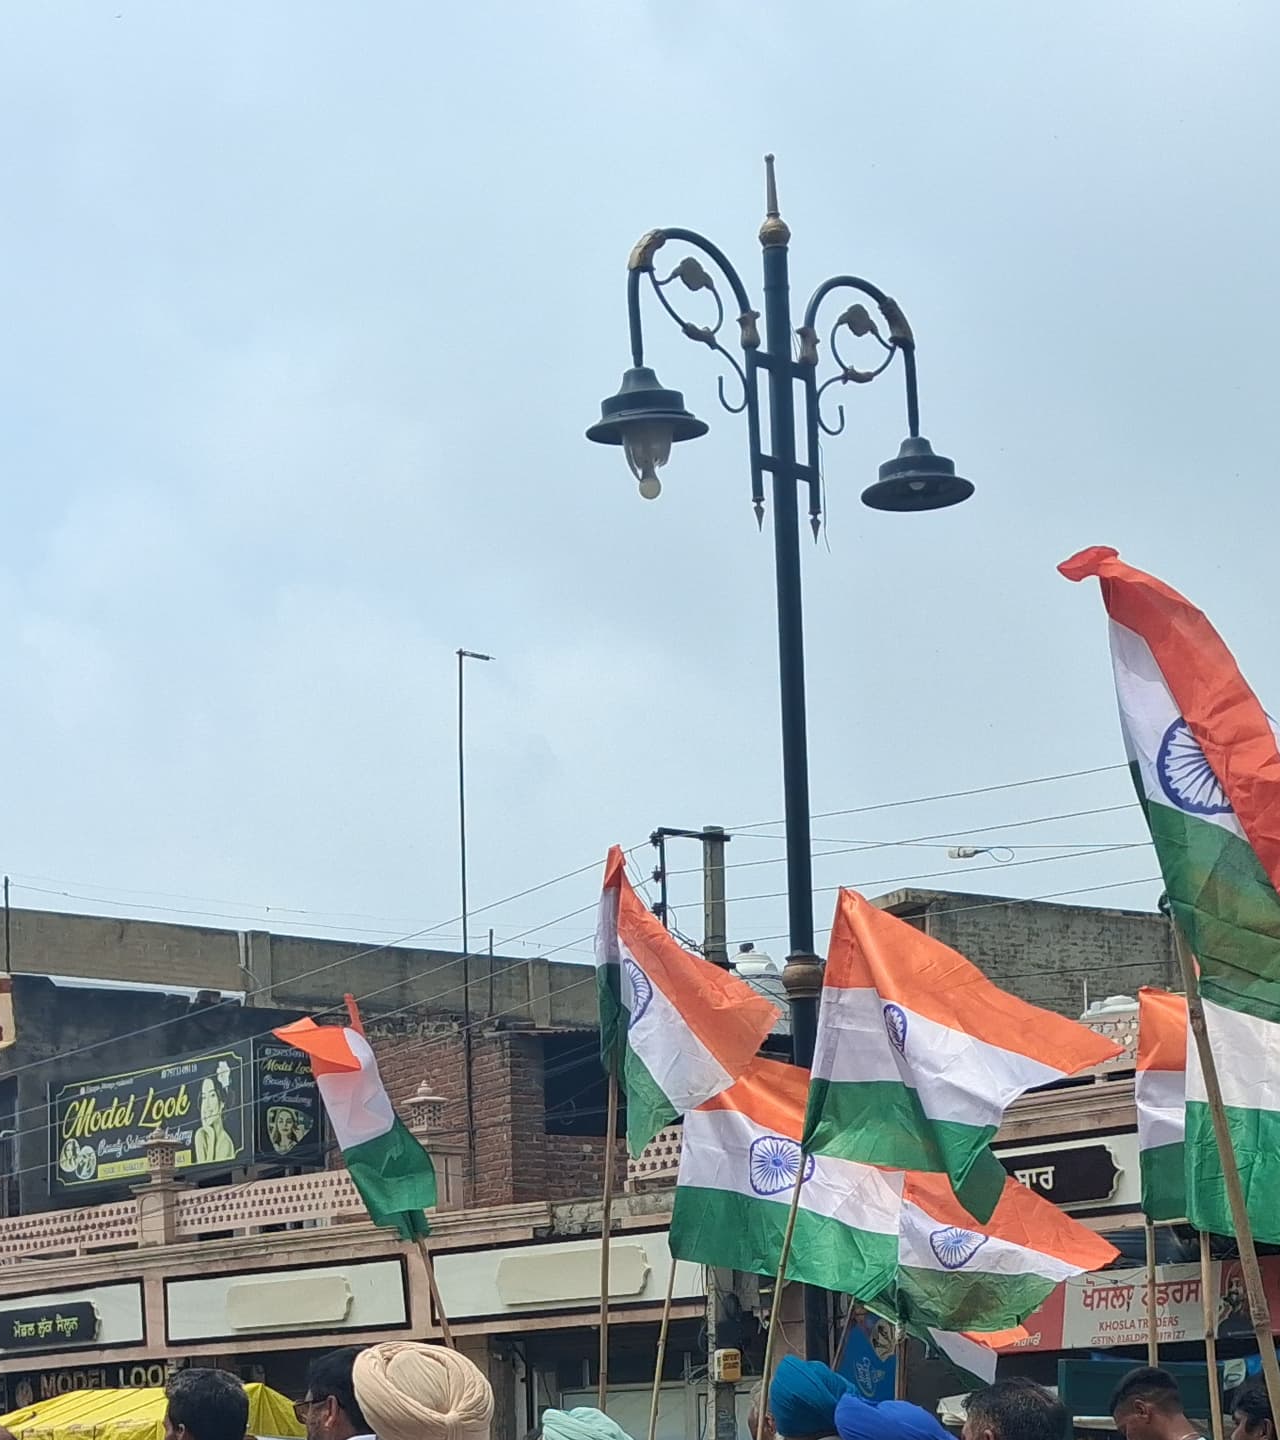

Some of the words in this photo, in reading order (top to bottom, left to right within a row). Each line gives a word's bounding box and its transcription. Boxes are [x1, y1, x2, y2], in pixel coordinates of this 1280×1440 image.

[262, 1059, 293, 1073] Model
[293, 1061, 313, 1075] Loo
[63, 1094, 136, 1140] Model
[137, 1084, 191, 1128] Look
[1098, 1320, 1136, 1331] KHOSLA
[1138, 1316, 1179, 1329] TRDERS
[40, 1369, 106, 1399] MODEL
